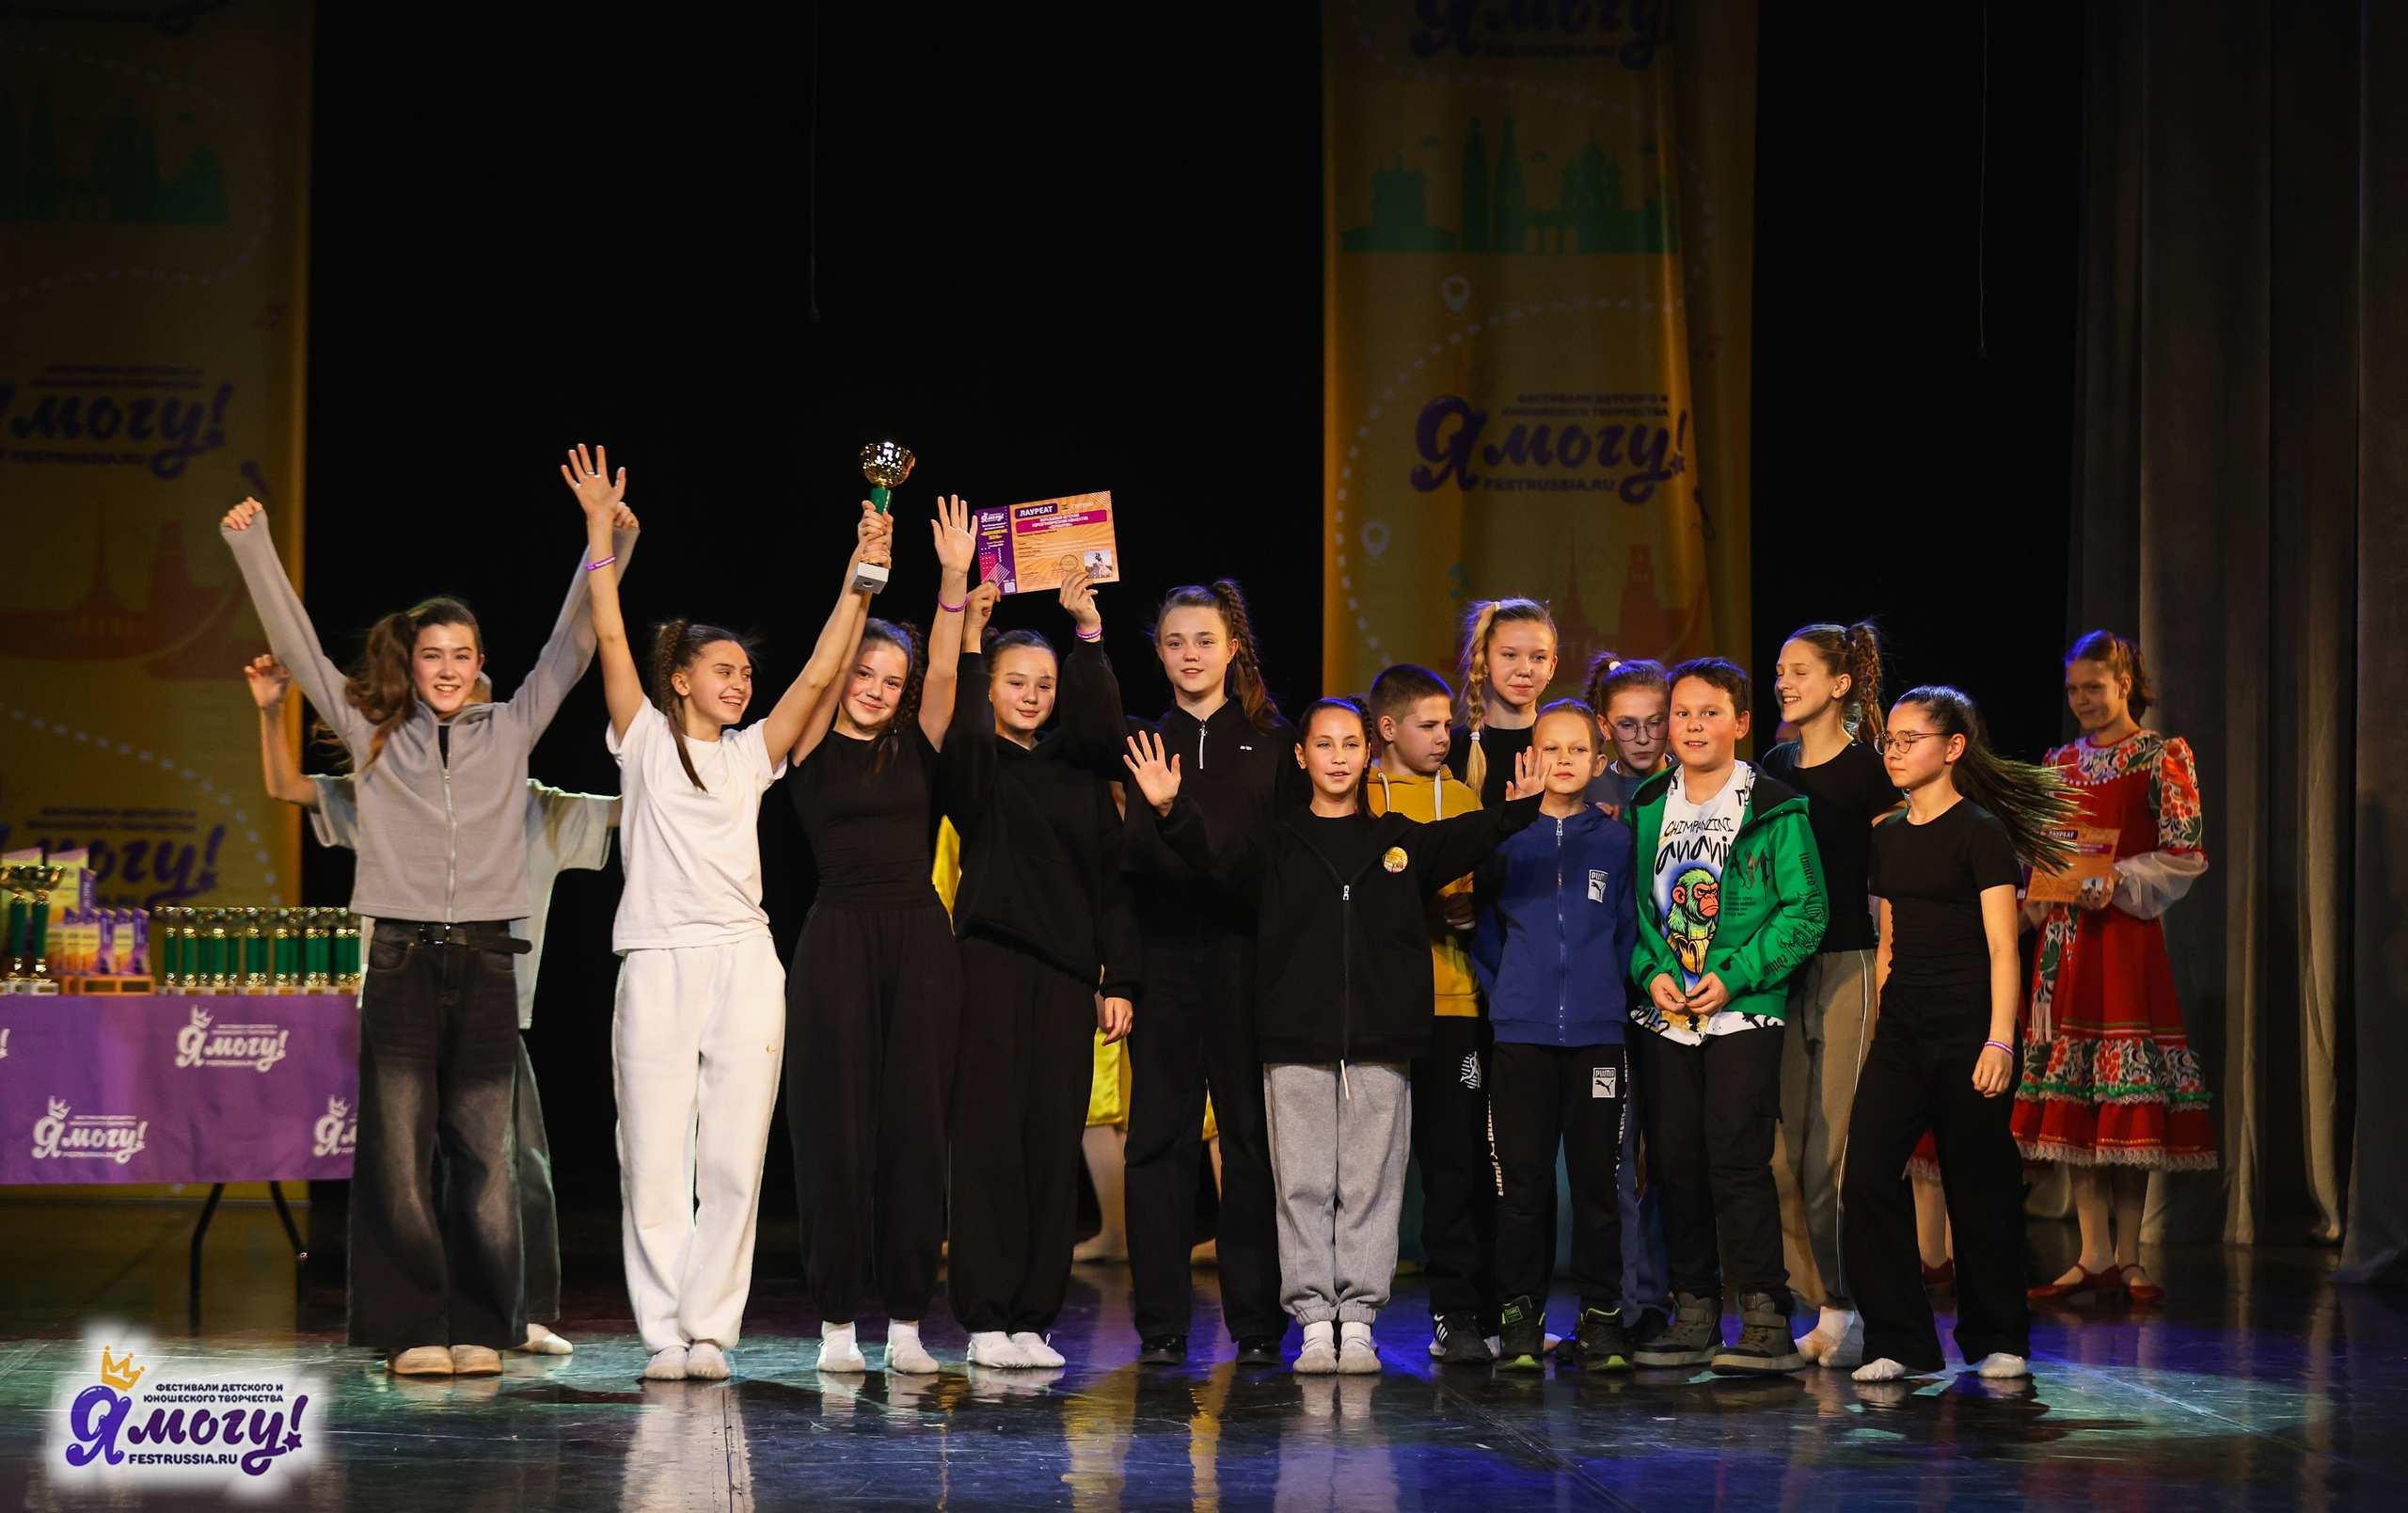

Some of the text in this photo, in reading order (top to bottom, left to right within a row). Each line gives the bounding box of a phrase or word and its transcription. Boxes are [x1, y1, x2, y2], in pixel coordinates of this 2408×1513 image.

[1410, 394, 1687, 505] Я могу!
[1484, 478, 1615, 491] FESTRUSSIA.RU
[1019, 505, 1054, 518] ЛАУРЕАТ
[1664, 817, 1735, 837] CHIMPANZINI
[176, 1024, 290, 1074] Я могу!
[32, 1115, 149, 1165] Я могу!
